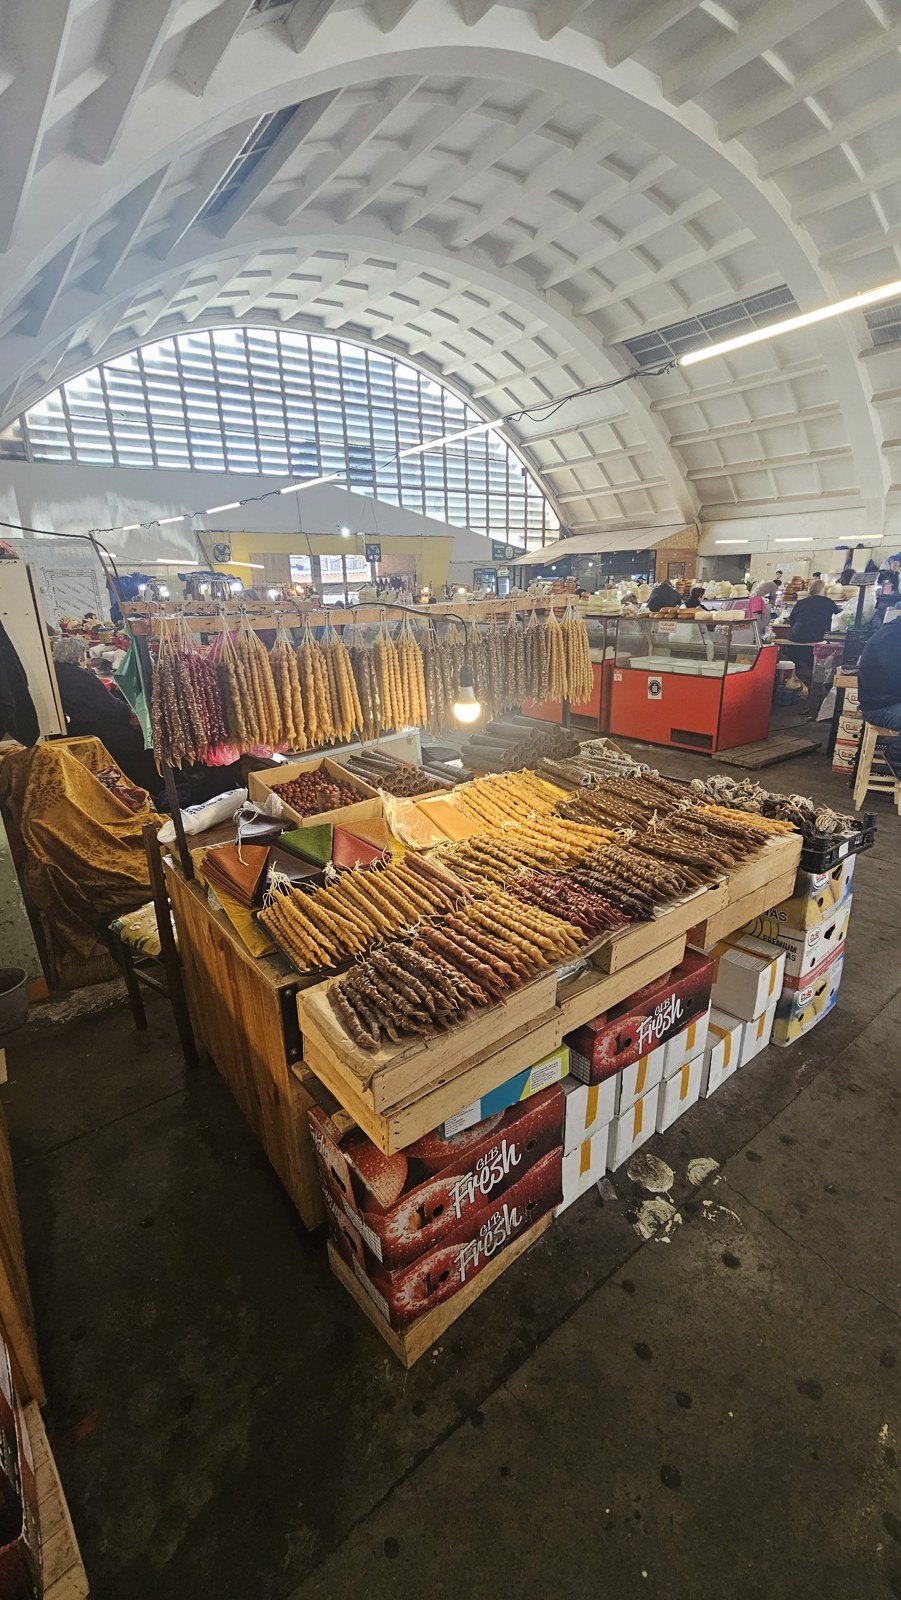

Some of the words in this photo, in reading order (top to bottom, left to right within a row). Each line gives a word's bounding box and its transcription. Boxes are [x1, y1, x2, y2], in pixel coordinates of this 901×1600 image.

[655, 998, 670, 1016] GLB
[800, 989, 813, 1001] Dole
[636, 993, 684, 1055] Fresh
[476, 1146, 499, 1171] GLB
[448, 1139, 522, 1219] Fresh
[480, 1211, 503, 1237] GLB
[453, 1203, 523, 1282] Fresh
